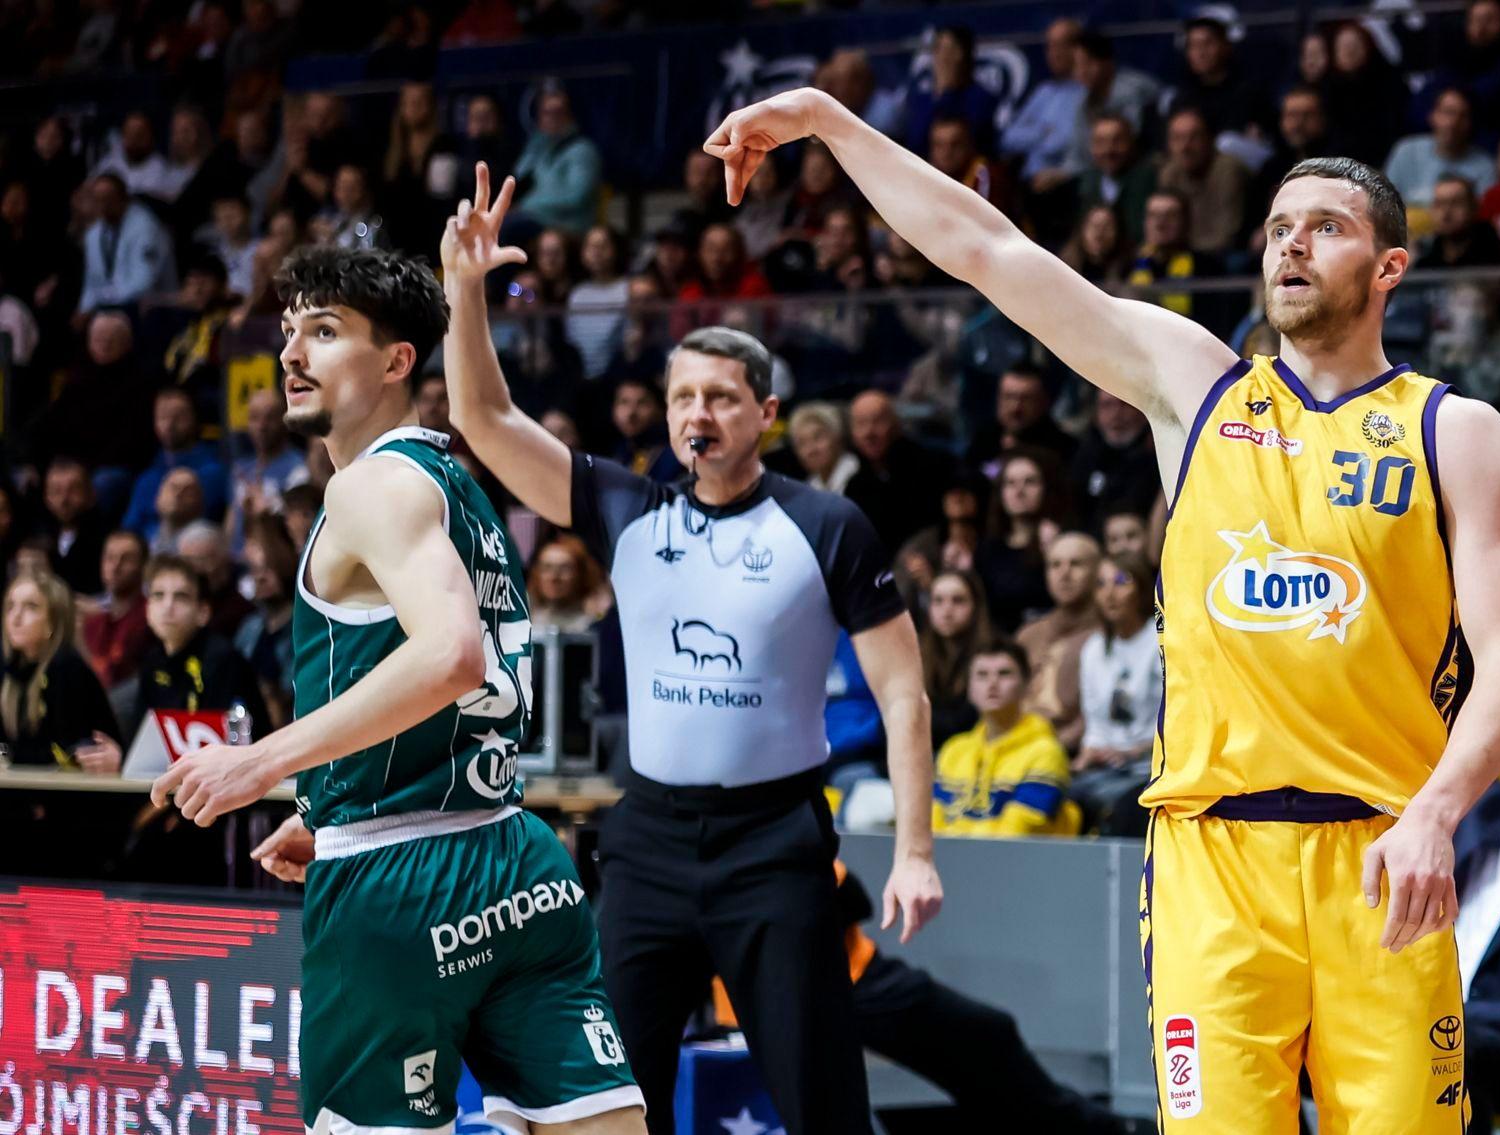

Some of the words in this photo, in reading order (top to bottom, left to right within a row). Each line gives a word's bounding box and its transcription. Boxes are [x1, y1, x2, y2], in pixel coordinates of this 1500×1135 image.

[1223, 425, 1261, 442] ORLEN
[1327, 449, 1416, 517] 30
[1244, 568, 1331, 609] LOTTO
[653, 679, 692, 705] Bank
[699, 687, 762, 709] Pekao
[430, 879, 574, 962] pompax
[437, 948, 494, 979] SERWIS
[1166, 1029, 1193, 1040] ORLEN
[1170, 1089, 1196, 1100] Basket
[1175, 1100, 1191, 1110] Liga
[1436, 1080, 1462, 1107] 4F
